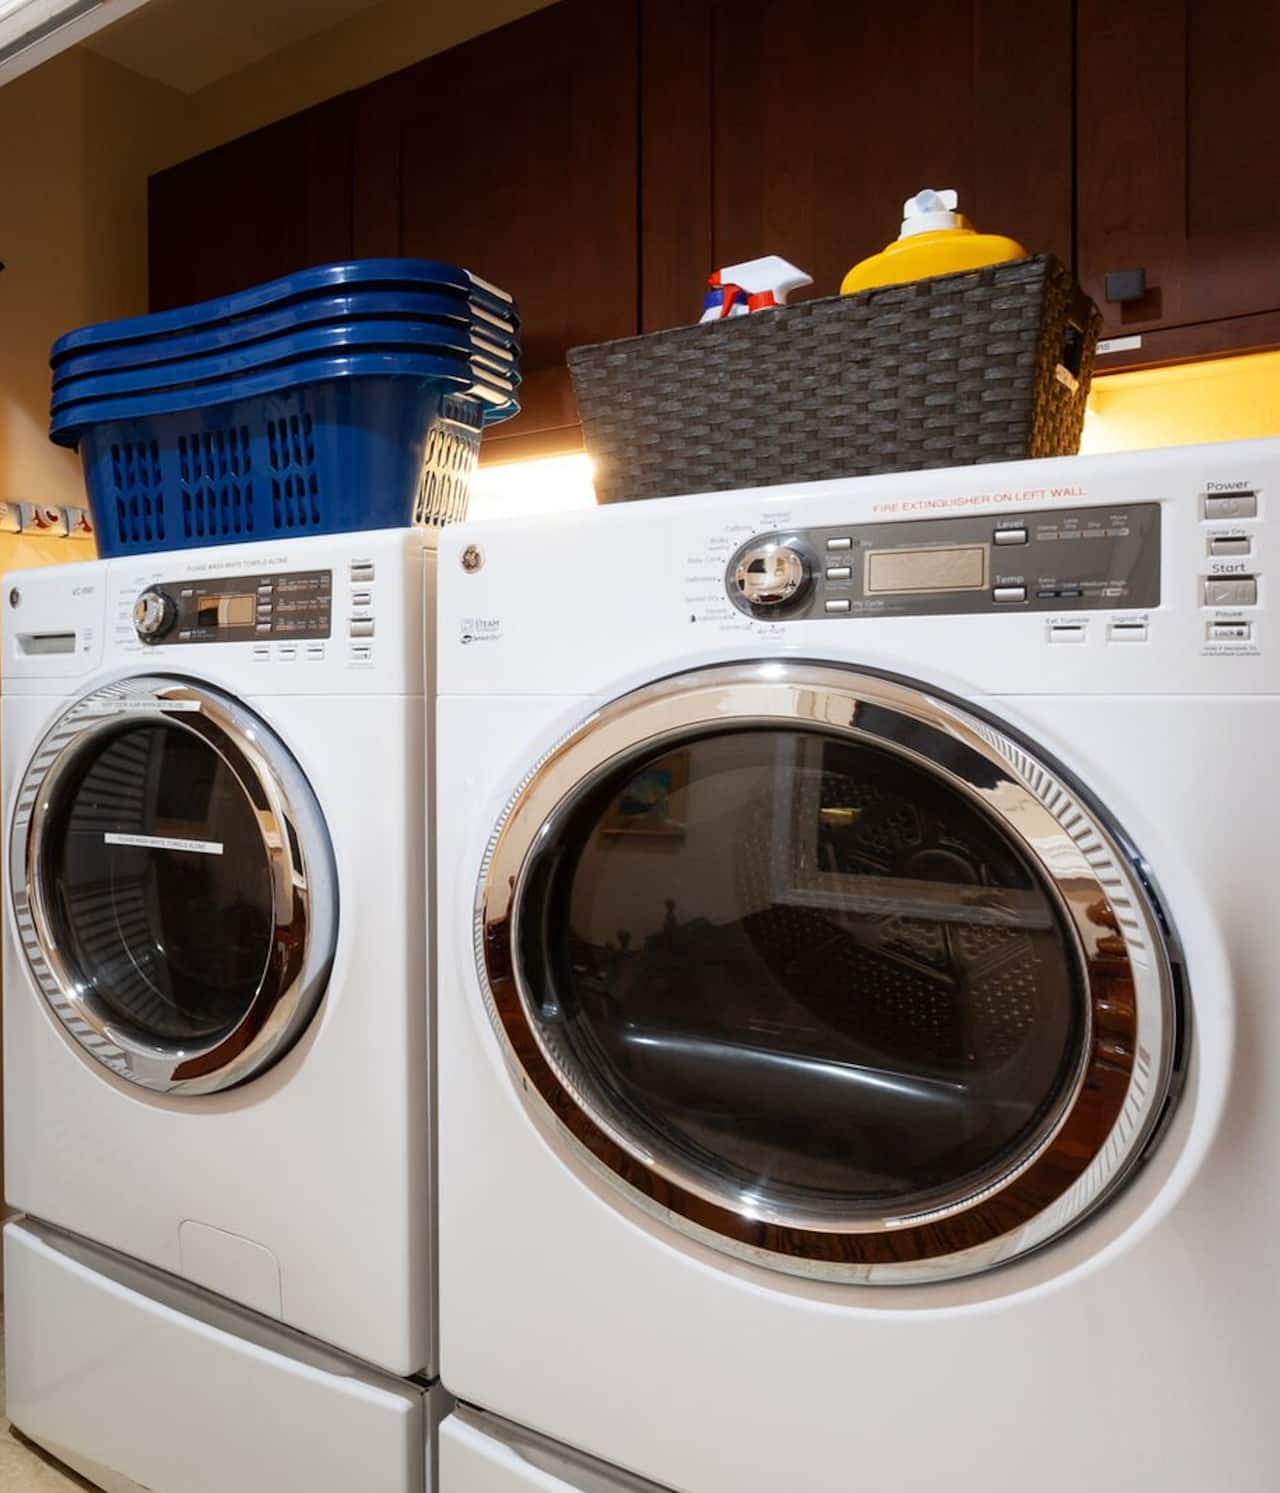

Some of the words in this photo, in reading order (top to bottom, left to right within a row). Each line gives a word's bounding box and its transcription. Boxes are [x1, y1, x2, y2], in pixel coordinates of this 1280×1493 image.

[1206, 480, 1249, 491] Power
[873, 502, 898, 514] FIRE
[902, 495, 990, 512] EXTINGUISHER
[993, 492, 1012, 503] ON
[1015, 490, 1046, 501] LEFT
[1050, 486, 1089, 498] WALL
[997, 518, 1024, 529] Level
[1211, 562, 1246, 574] Start
[995, 574, 1024, 585] Temp
